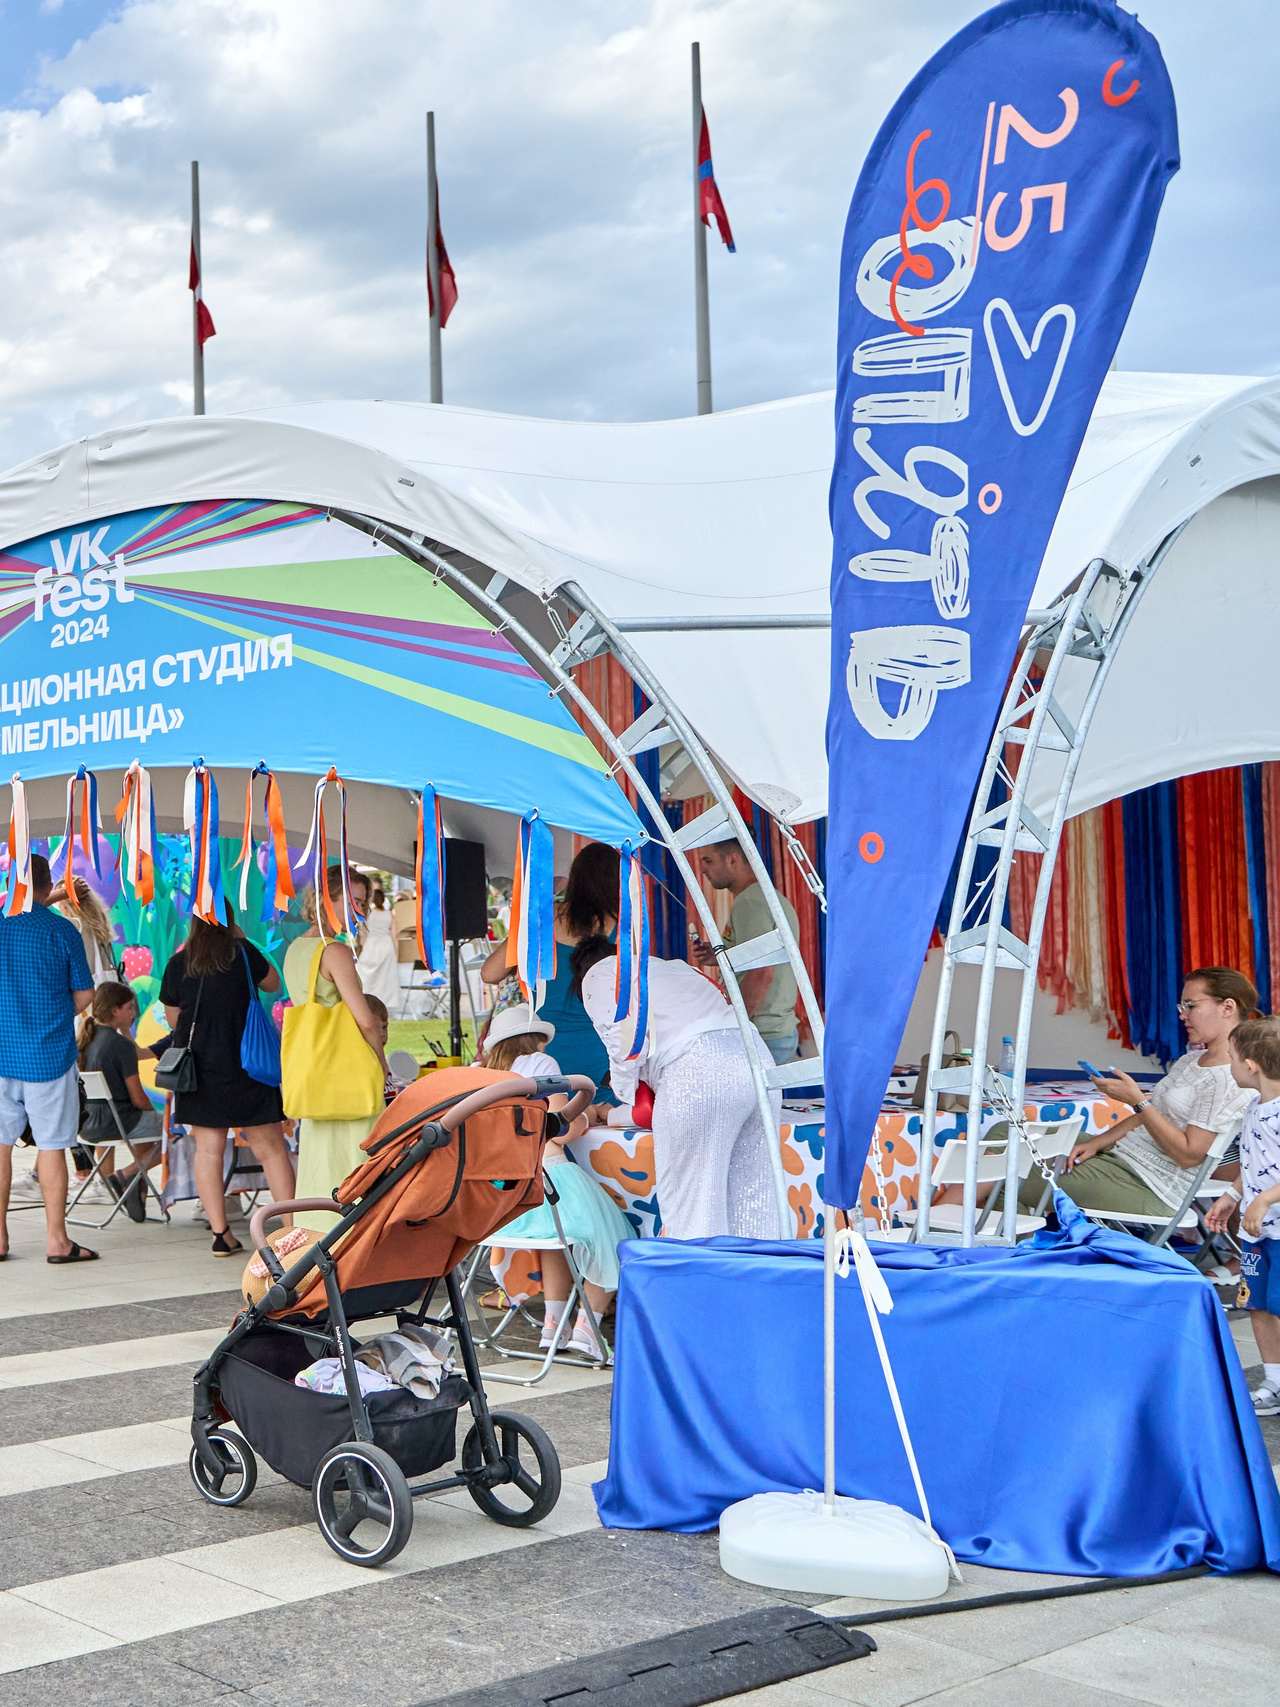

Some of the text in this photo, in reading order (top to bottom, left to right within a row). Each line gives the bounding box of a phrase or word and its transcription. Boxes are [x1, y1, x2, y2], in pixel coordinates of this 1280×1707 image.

[984, 87, 1079, 252] 25
[50, 525, 112, 575] VK
[34, 553, 135, 622] fest
[50, 614, 110, 648] 2024
[152, 633, 294, 687] СТУДИЯ
